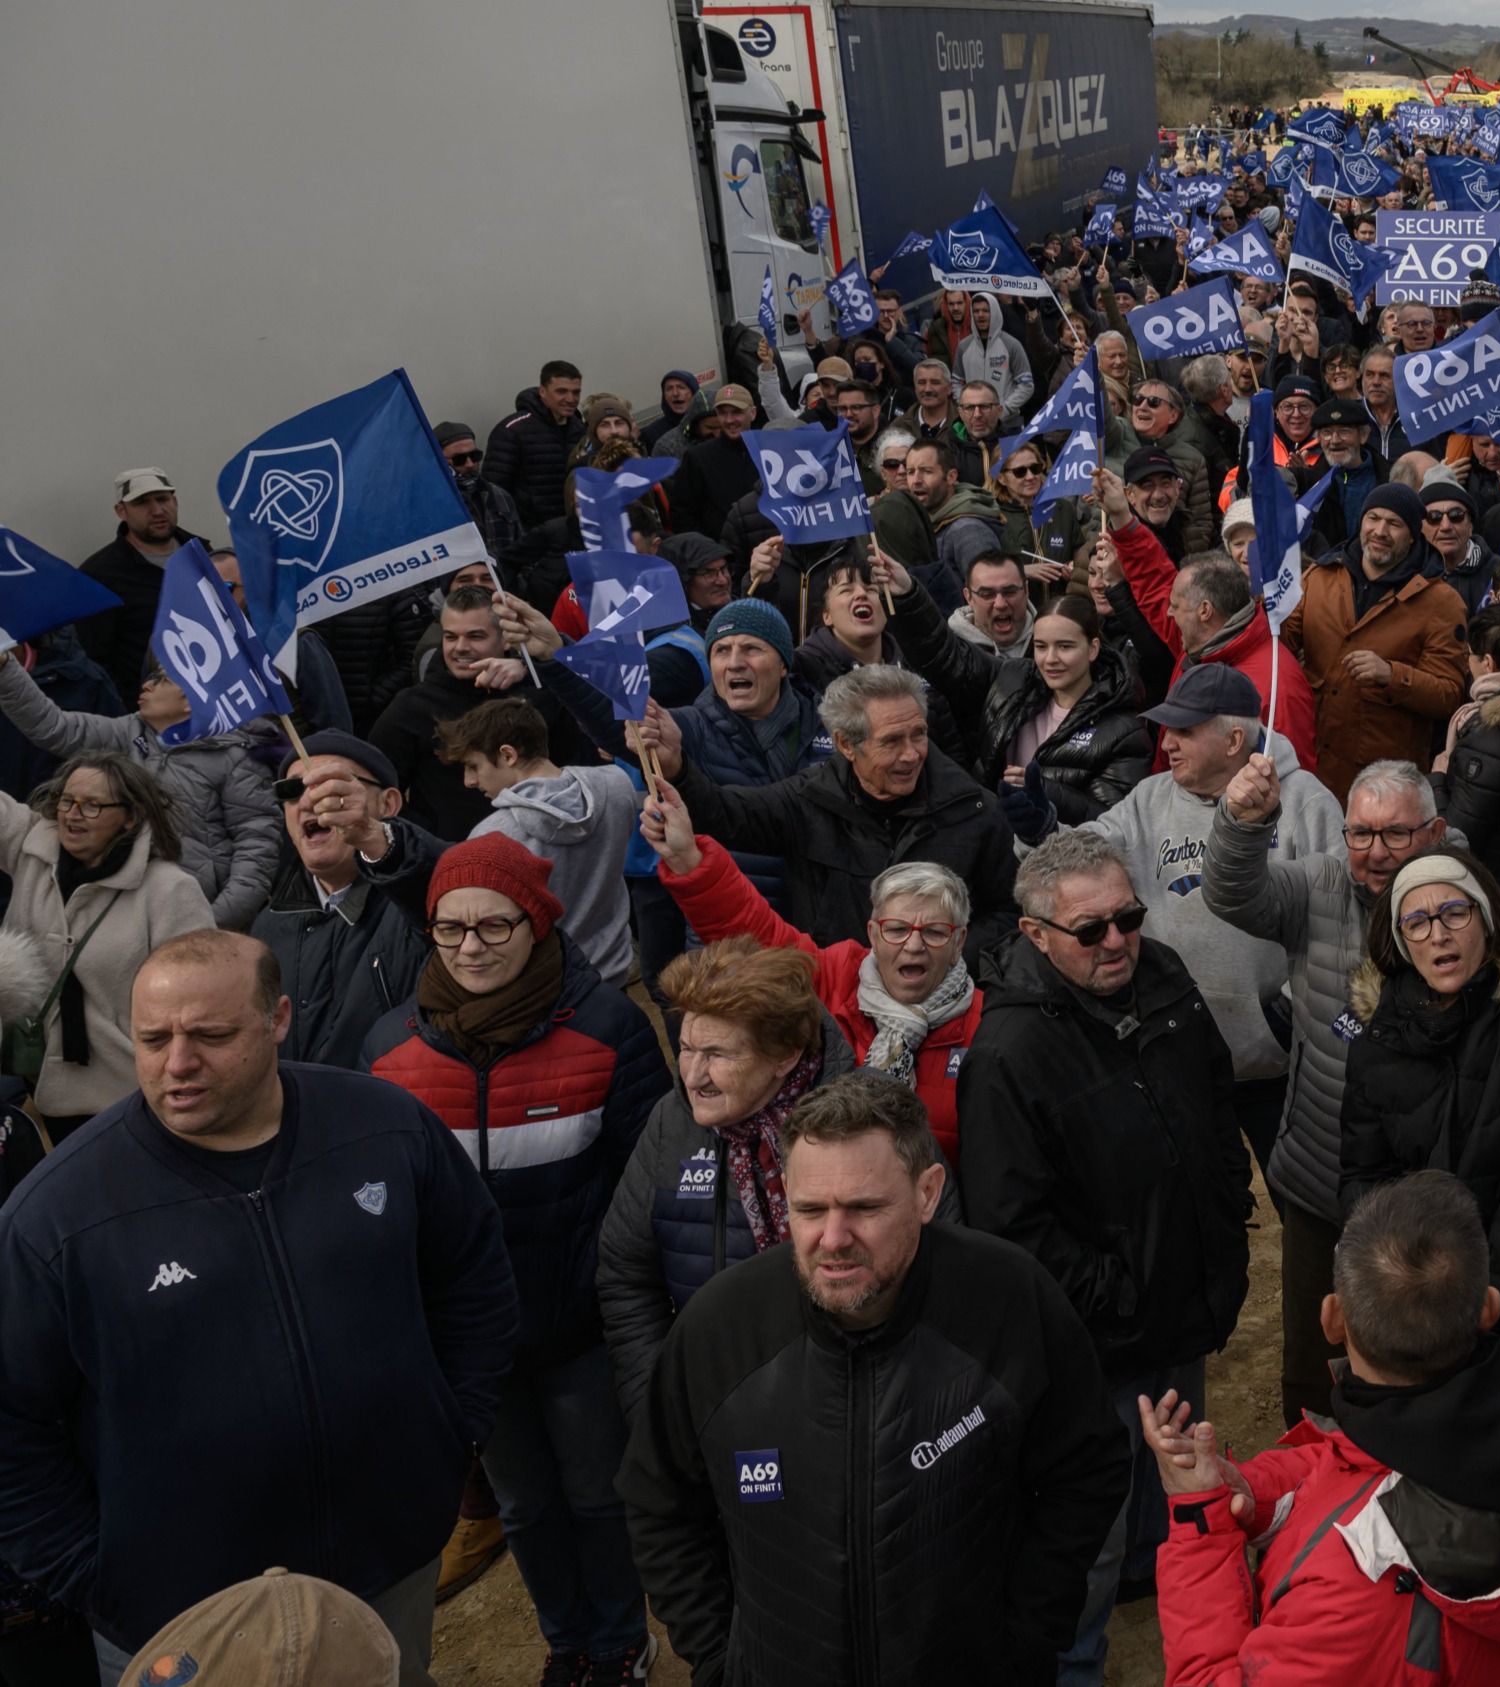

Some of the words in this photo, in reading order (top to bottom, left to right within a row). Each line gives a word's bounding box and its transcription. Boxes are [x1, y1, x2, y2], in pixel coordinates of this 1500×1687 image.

[936, 31, 984, 81] Groupe
[760, 60, 792, 72] trans
[1419, 106, 1435, 115] NTÉ
[940, 74, 1108, 167] BLAZQUEZ
[1395, 215, 1486, 235] SECURITÉ
[1393, 243, 1488, 280] A69
[829, 285, 842, 301] ON
[840, 272, 873, 323] A69
[1391, 288, 1425, 305] ON
[1430, 288, 1461, 305] FIN
[1071, 732, 1093, 740] A69
[1157, 836, 1206, 881] Canter
[1184, 860, 1191, 871] of
[1333, 1021, 1343, 1031] ON
[1337, 1013, 1363, 1035] A69
[680, 1169, 716, 1183] A69
[936, 1424, 968, 1455] adam
[963, 1405, 986, 1431] hall
[740, 1462, 778, 1482] A69
[741, 1484, 753, 1494] ON
[754, 1482, 776, 1493] FINIT
